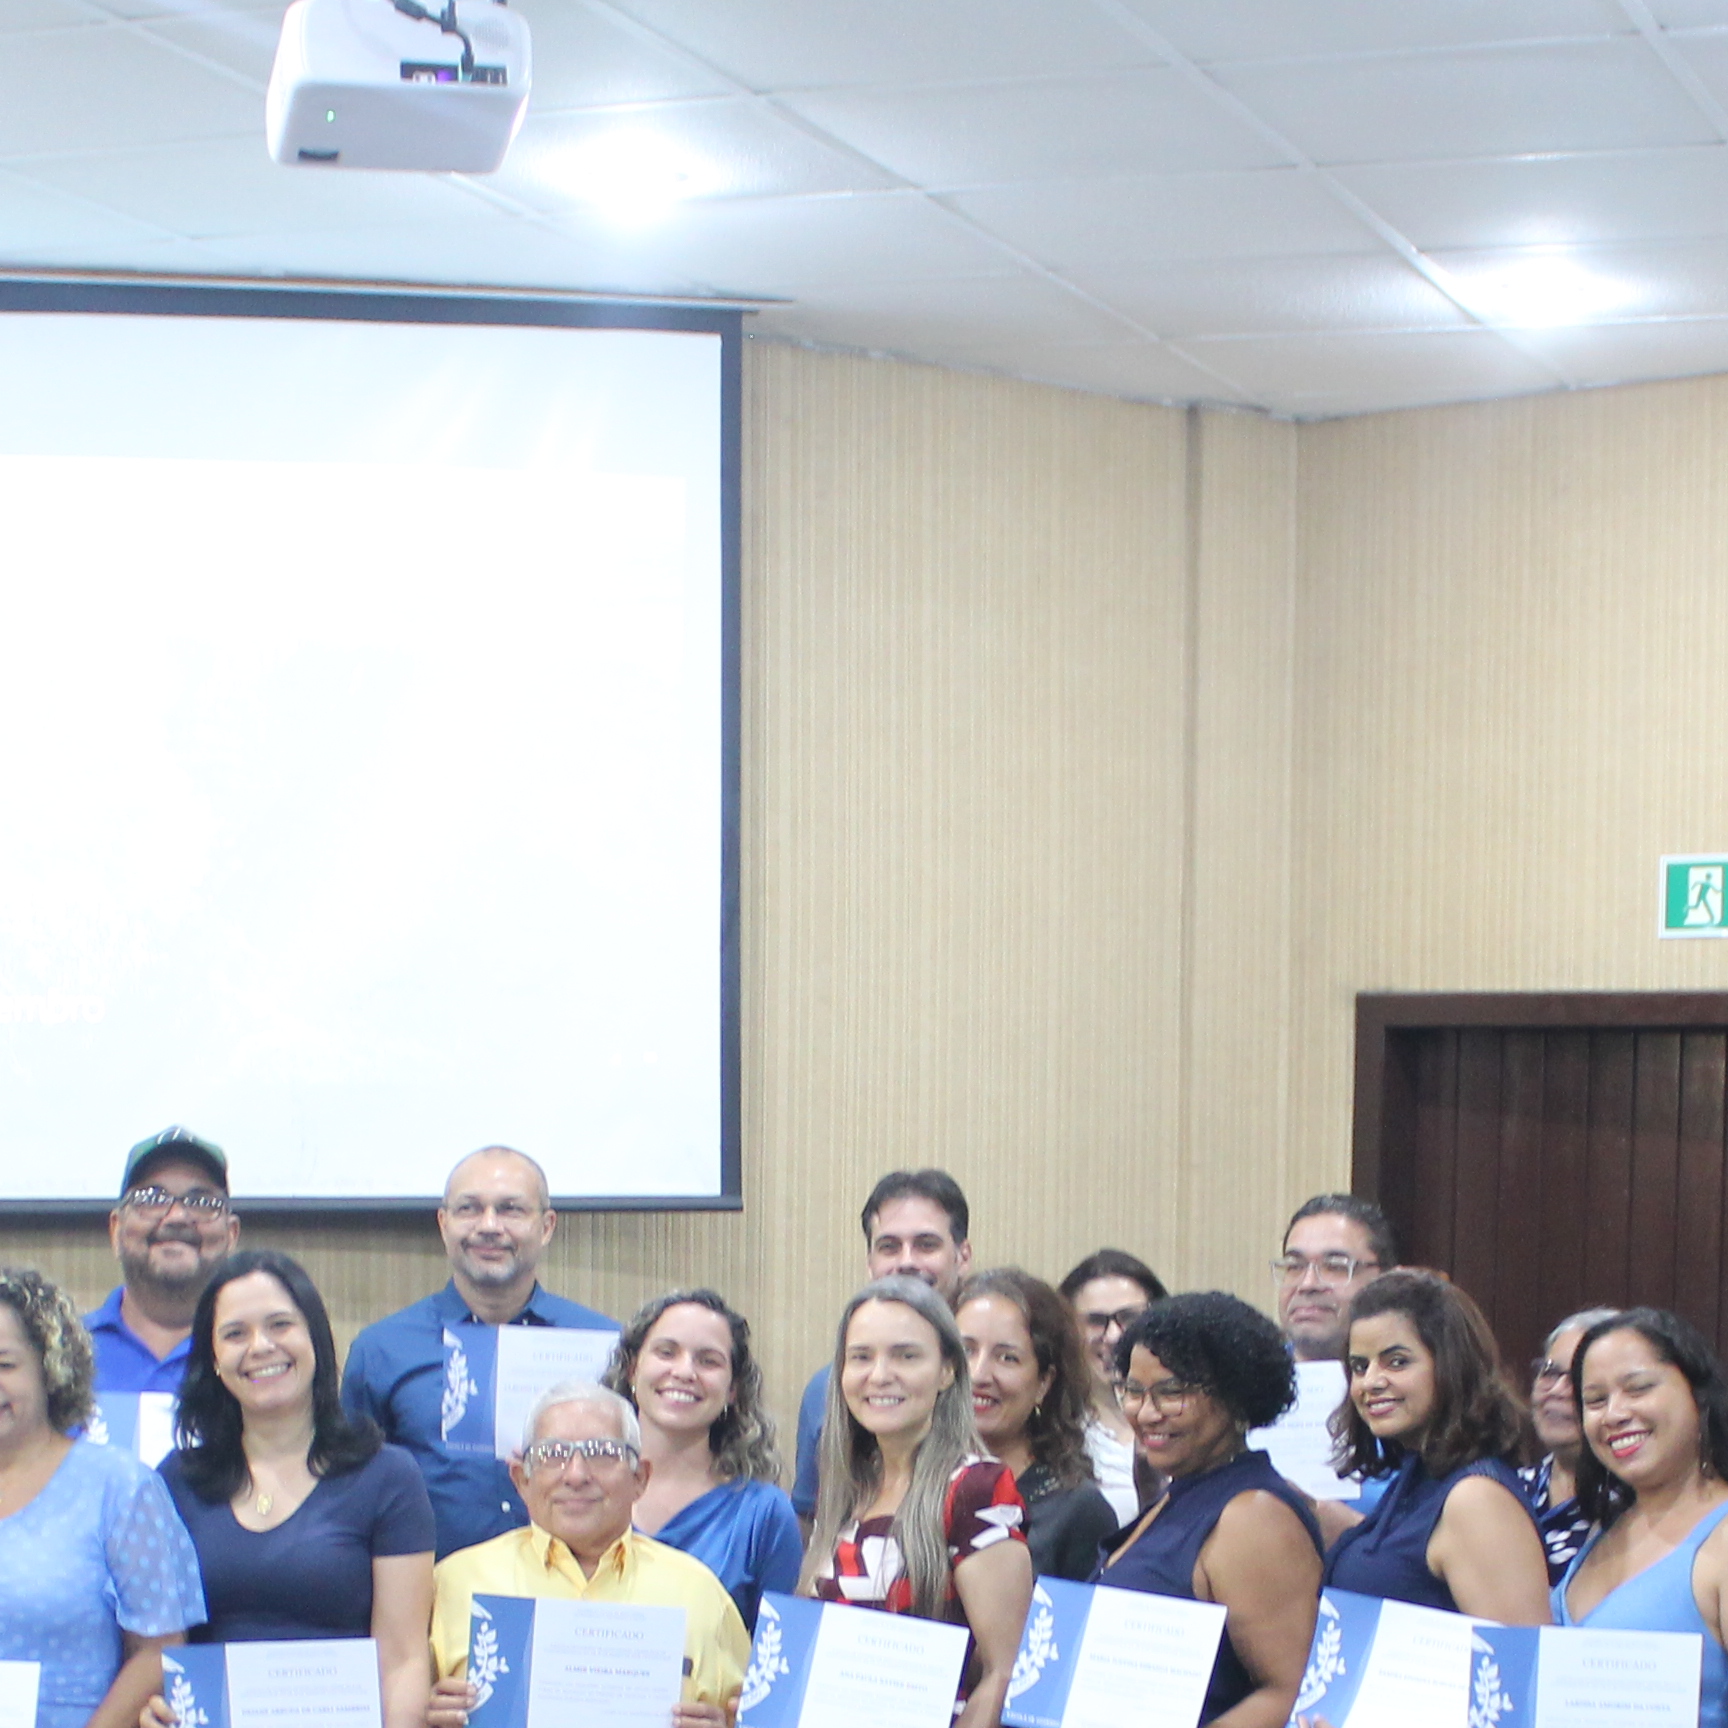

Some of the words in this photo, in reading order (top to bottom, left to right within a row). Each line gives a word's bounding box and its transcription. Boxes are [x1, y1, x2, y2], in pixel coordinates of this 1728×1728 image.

[574, 1627, 645, 1641] CERTIFICADO
[857, 1634, 925, 1655] CERTIFICADO
[1582, 1657, 1658, 1672] CERTIFICADO
[267, 1665, 338, 1679] CERTIFICADO
